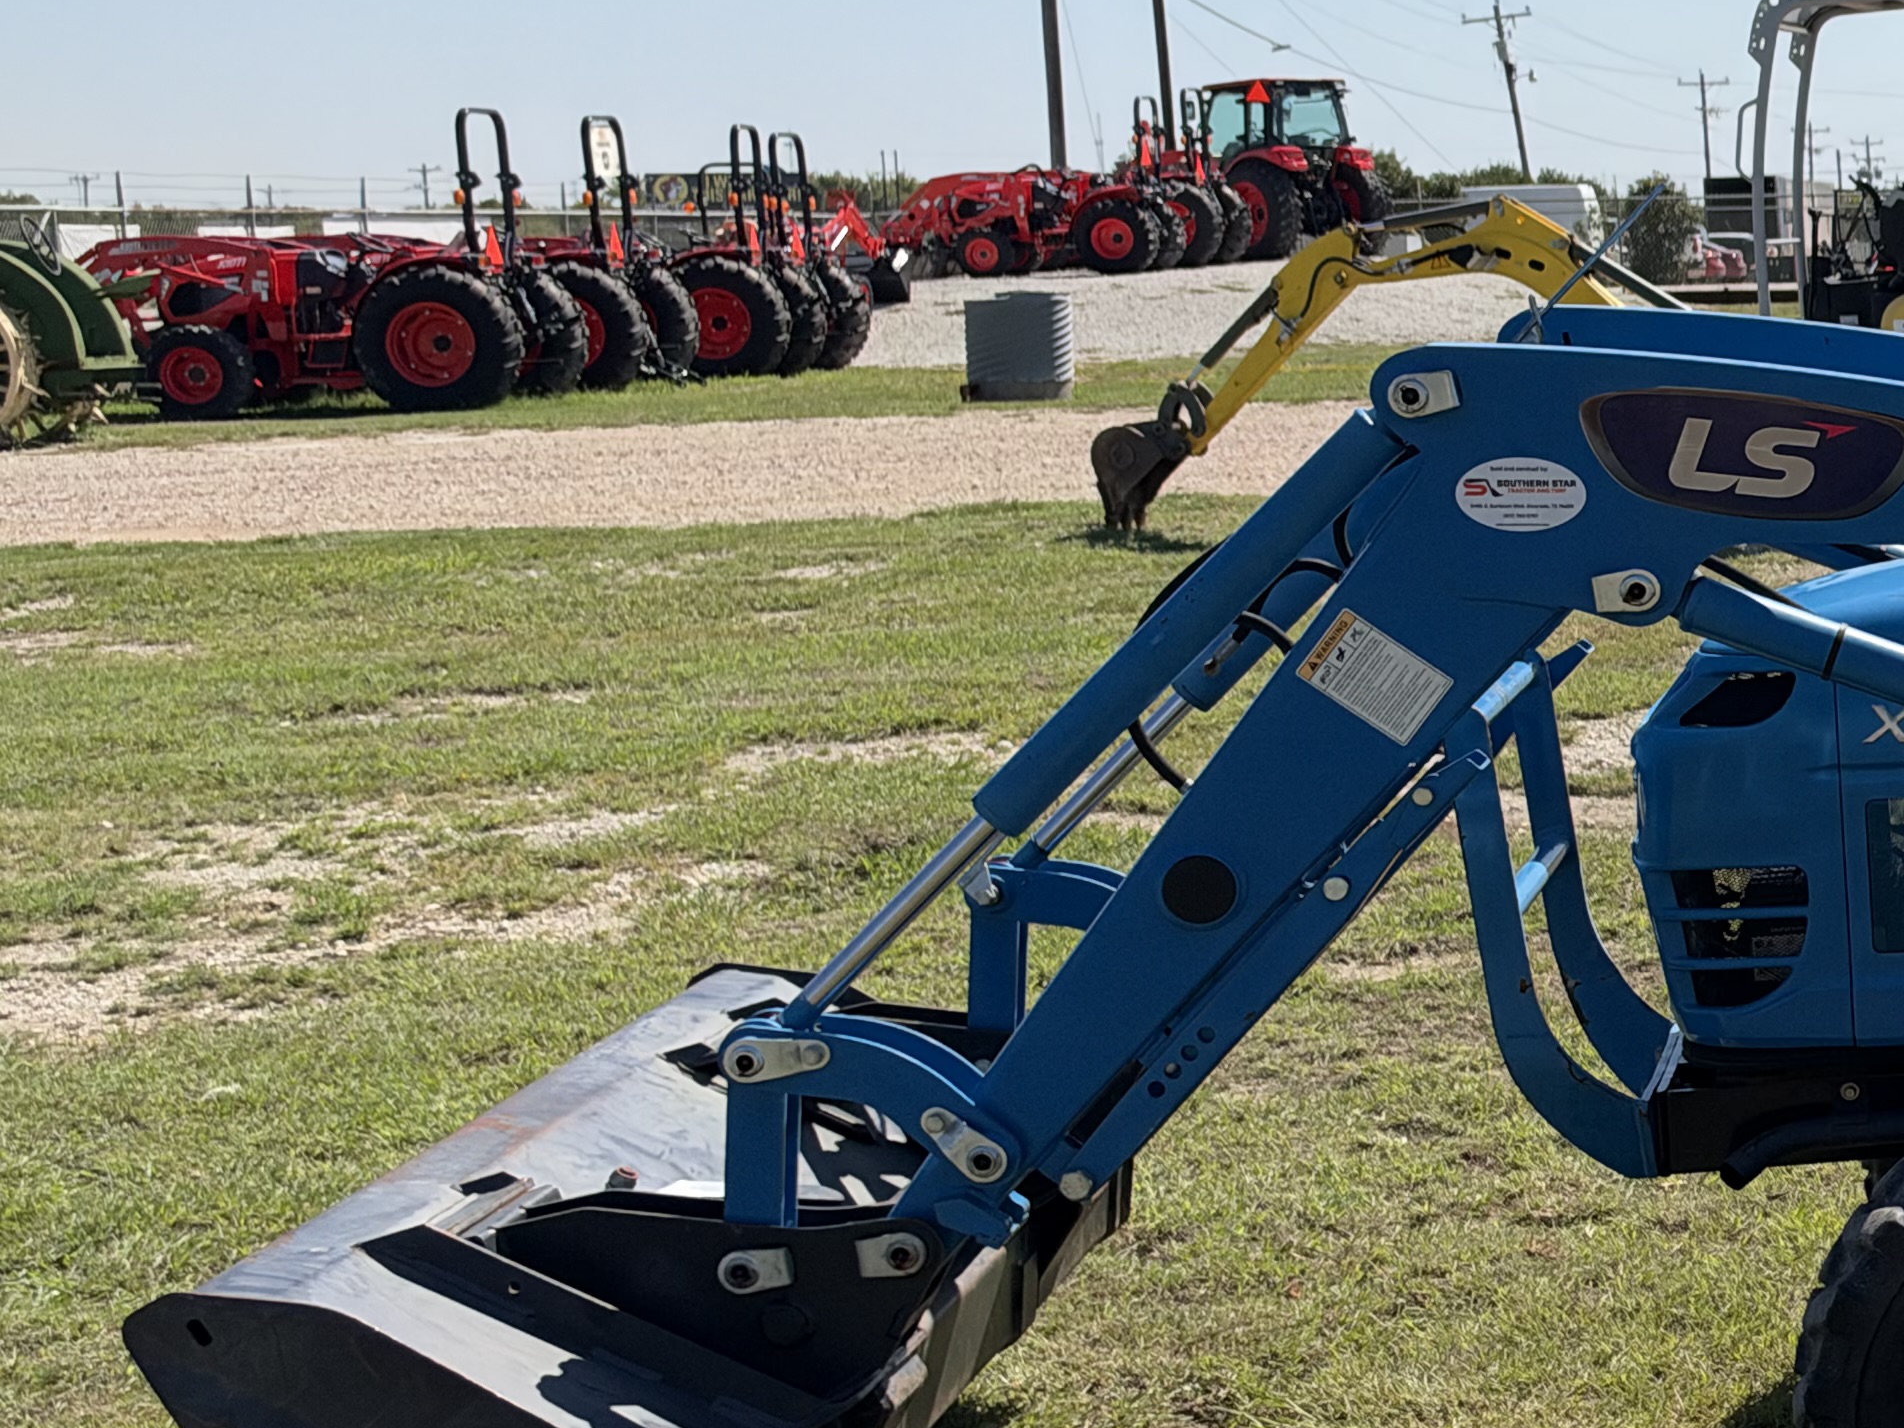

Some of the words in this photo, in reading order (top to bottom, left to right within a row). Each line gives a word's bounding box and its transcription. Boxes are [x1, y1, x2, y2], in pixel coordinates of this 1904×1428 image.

[1668, 417, 1821, 499] LS
[1497, 479, 1549, 487] SOUTHERN
[1551, 479, 1577, 487] STAR
[1314, 620, 1349, 661] WARNING
